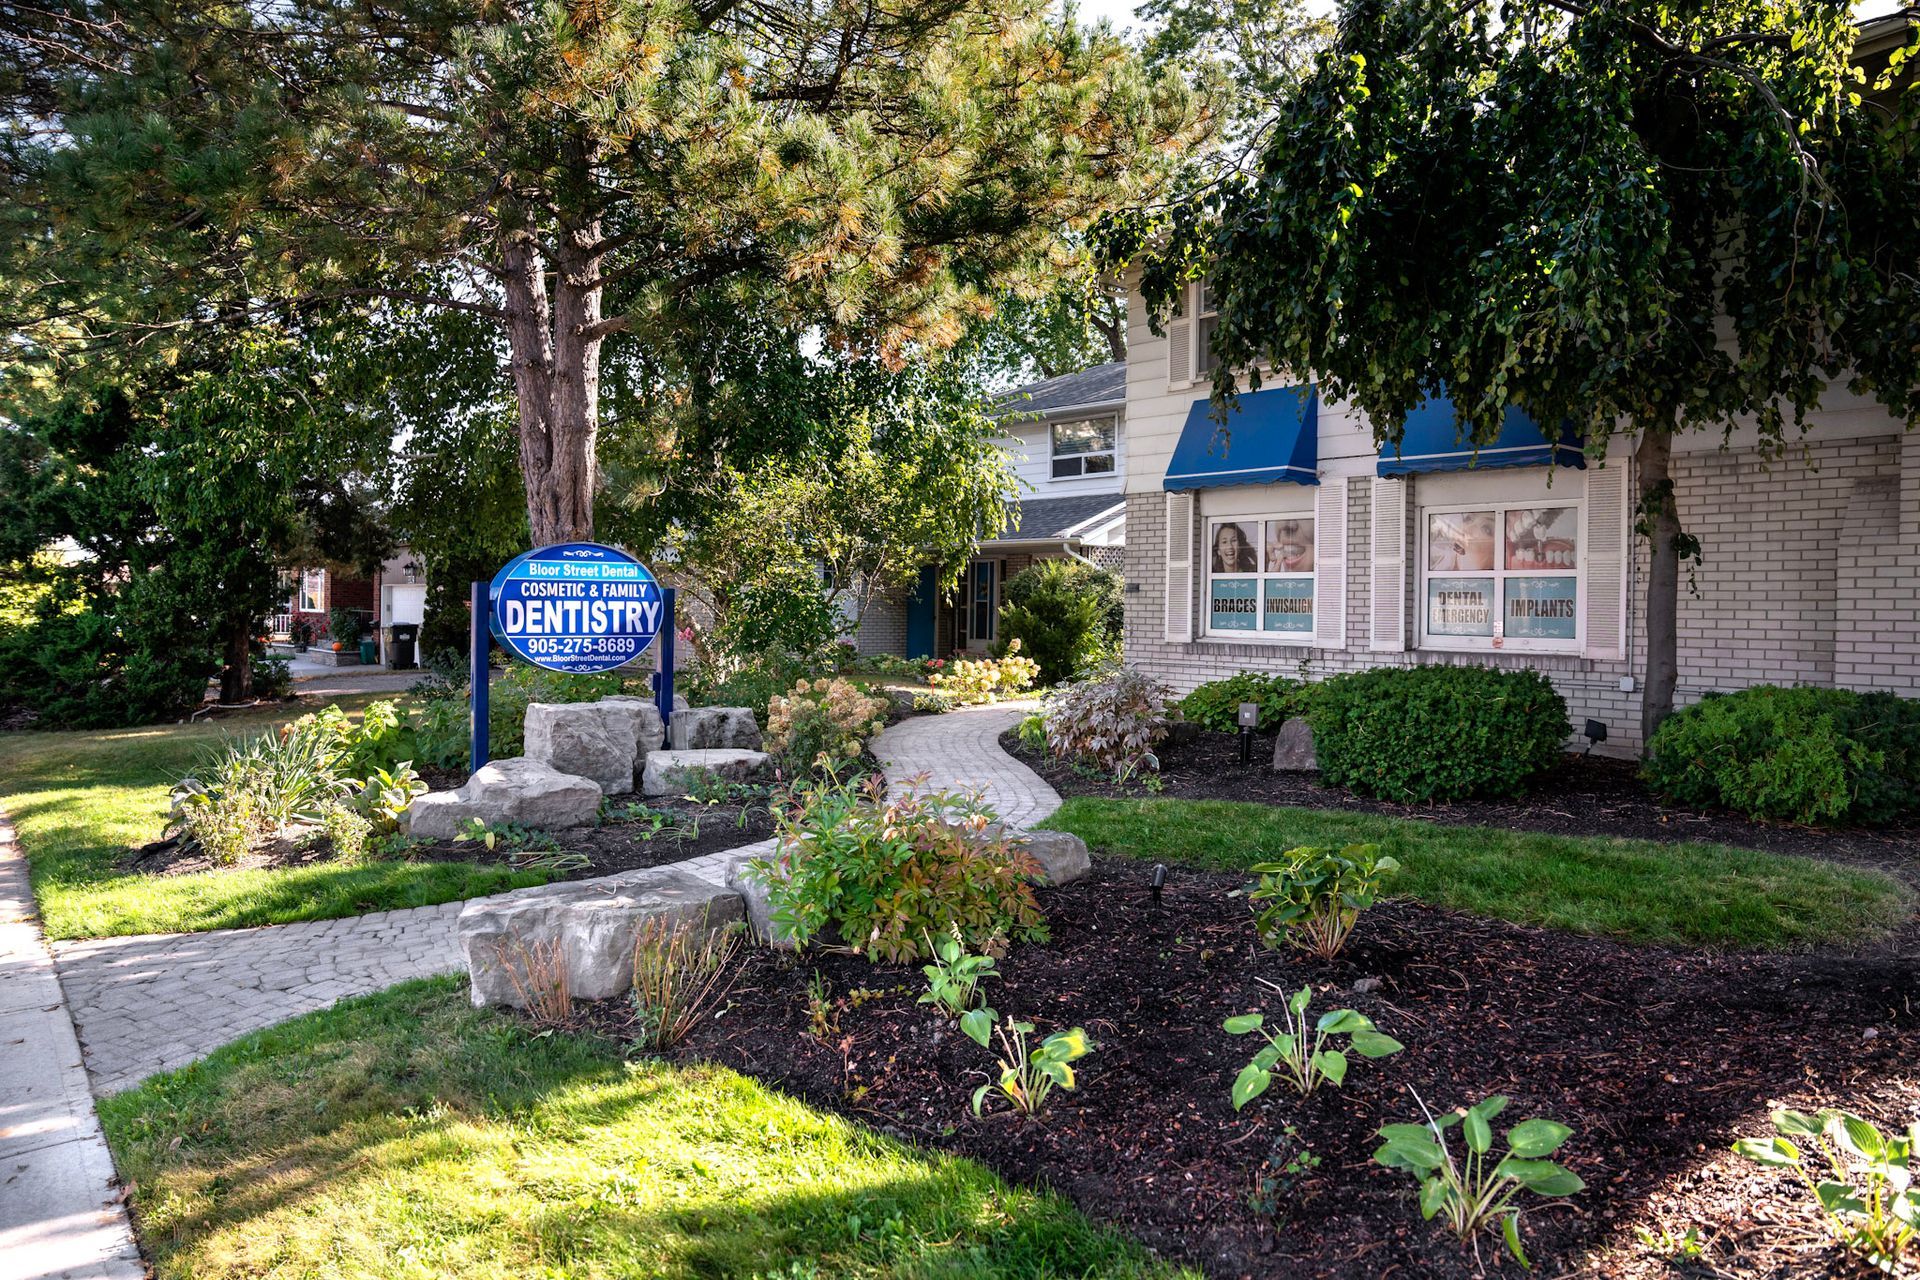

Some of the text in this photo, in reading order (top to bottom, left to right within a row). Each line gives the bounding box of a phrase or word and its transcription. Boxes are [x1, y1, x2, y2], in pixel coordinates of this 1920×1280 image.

[529, 563, 638, 577] Bloor Street Dental
[521, 582, 647, 598] COSMETIC & FAMILY
[1213, 598, 1257, 613] BRACES
[1266, 598, 1313, 614] INVISALIGN
[1438, 591, 1484, 606] DENTAL
[1432, 608, 1490, 624] EMERGENCY
[1511, 599, 1574, 617] IMPLANTS
[506, 600, 660, 634] DENTISTRY
[528, 638, 636, 654] 905-275-8689
[535, 654, 626, 663] www.BloorStreetDental.com
